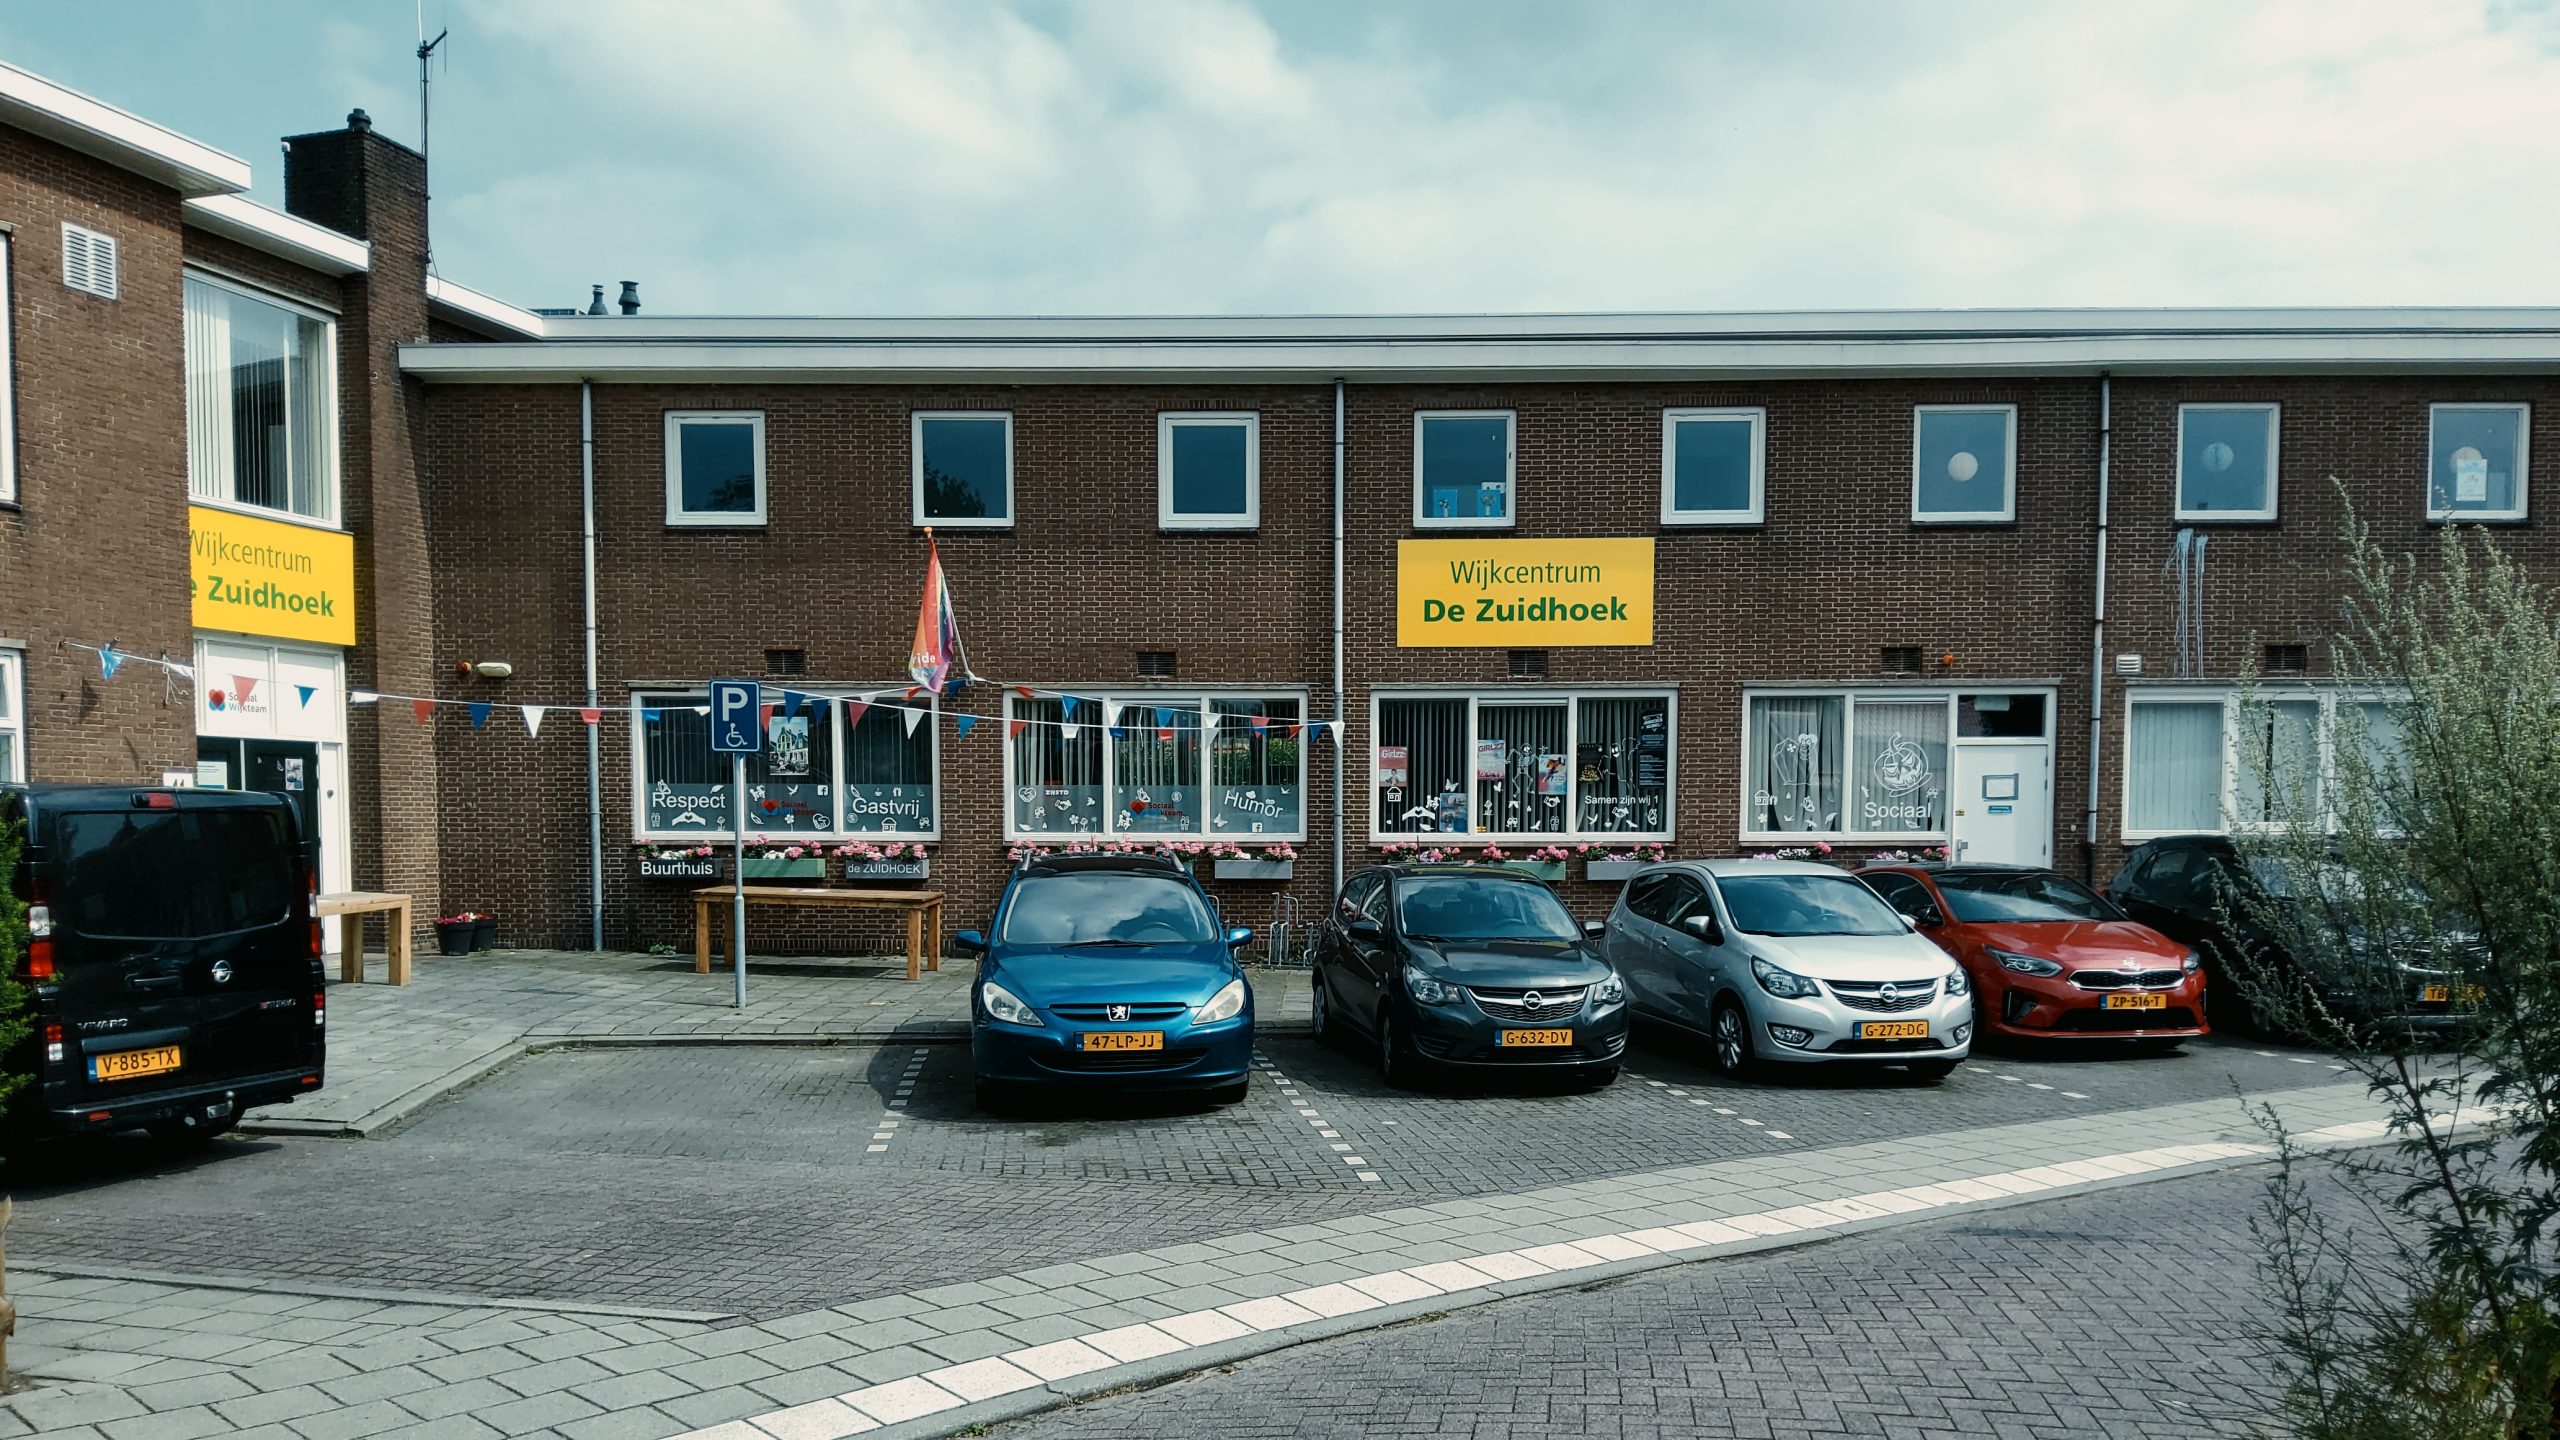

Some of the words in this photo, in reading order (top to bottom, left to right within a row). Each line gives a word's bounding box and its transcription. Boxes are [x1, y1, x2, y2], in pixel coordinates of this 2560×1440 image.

[1450, 558, 1601, 590] Wijkcentrum
[207, 575, 335, 618] Zuidhoek
[1424, 599, 1466, 622] De
[1476, 596, 1628, 622] Zuidhoek
[911, 652, 936, 665] ride
[722, 687, 748, 721] P
[1478, 742, 1504, 752] GIRLZZ
[652, 792, 726, 812] Respect
[1224, 789, 1284, 819] Humor
[1584, 795, 1618, 805] Samen
[1620, 795, 1636, 806] zijn
[1638, 795, 1651, 806] wij
[852, 798, 920, 819] Gastvrij
[1864, 801, 1931, 818] Sociaal
[641, 861, 713, 875] Buurthuis
[847, 864, 860, 873] de
[863, 863, 921, 874] ZUIDHOEK
[2112, 996, 2160, 1007] ZP-516-T
[1865, 1023, 1924, 1036] G-272-DG
[1091, 1035, 1154, 1048] 47-LP-JJ
[1506, 1032, 1568, 1044] G-632-DV
[102, 1048, 175, 1073] V-885-TX
